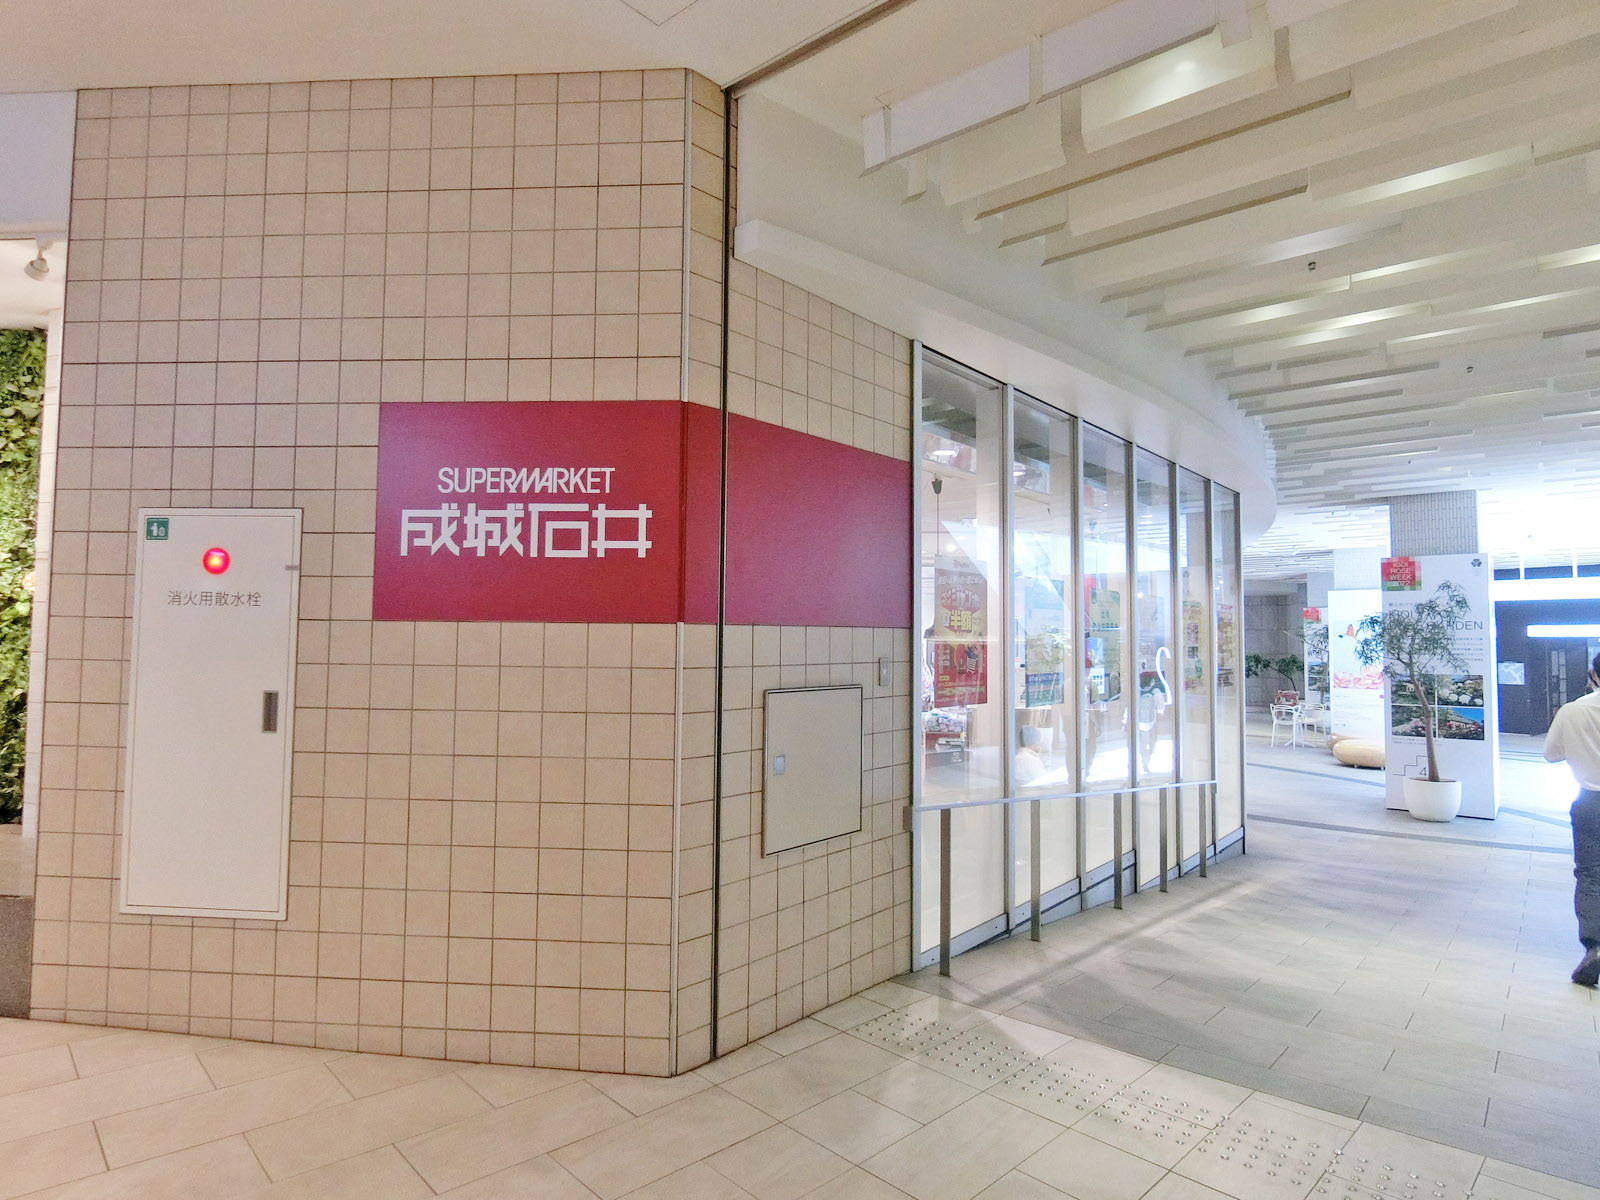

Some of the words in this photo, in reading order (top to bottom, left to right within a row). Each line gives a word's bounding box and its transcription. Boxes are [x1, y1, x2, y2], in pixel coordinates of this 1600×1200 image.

[437, 466, 616, 494] SUPERMARKET
[400, 502, 653, 558] 成城石井
[1389, 573, 1412, 581] WEEK
[167, 590, 262, 607] 消火用散水栓
[950, 609, 972, 631] 半額
